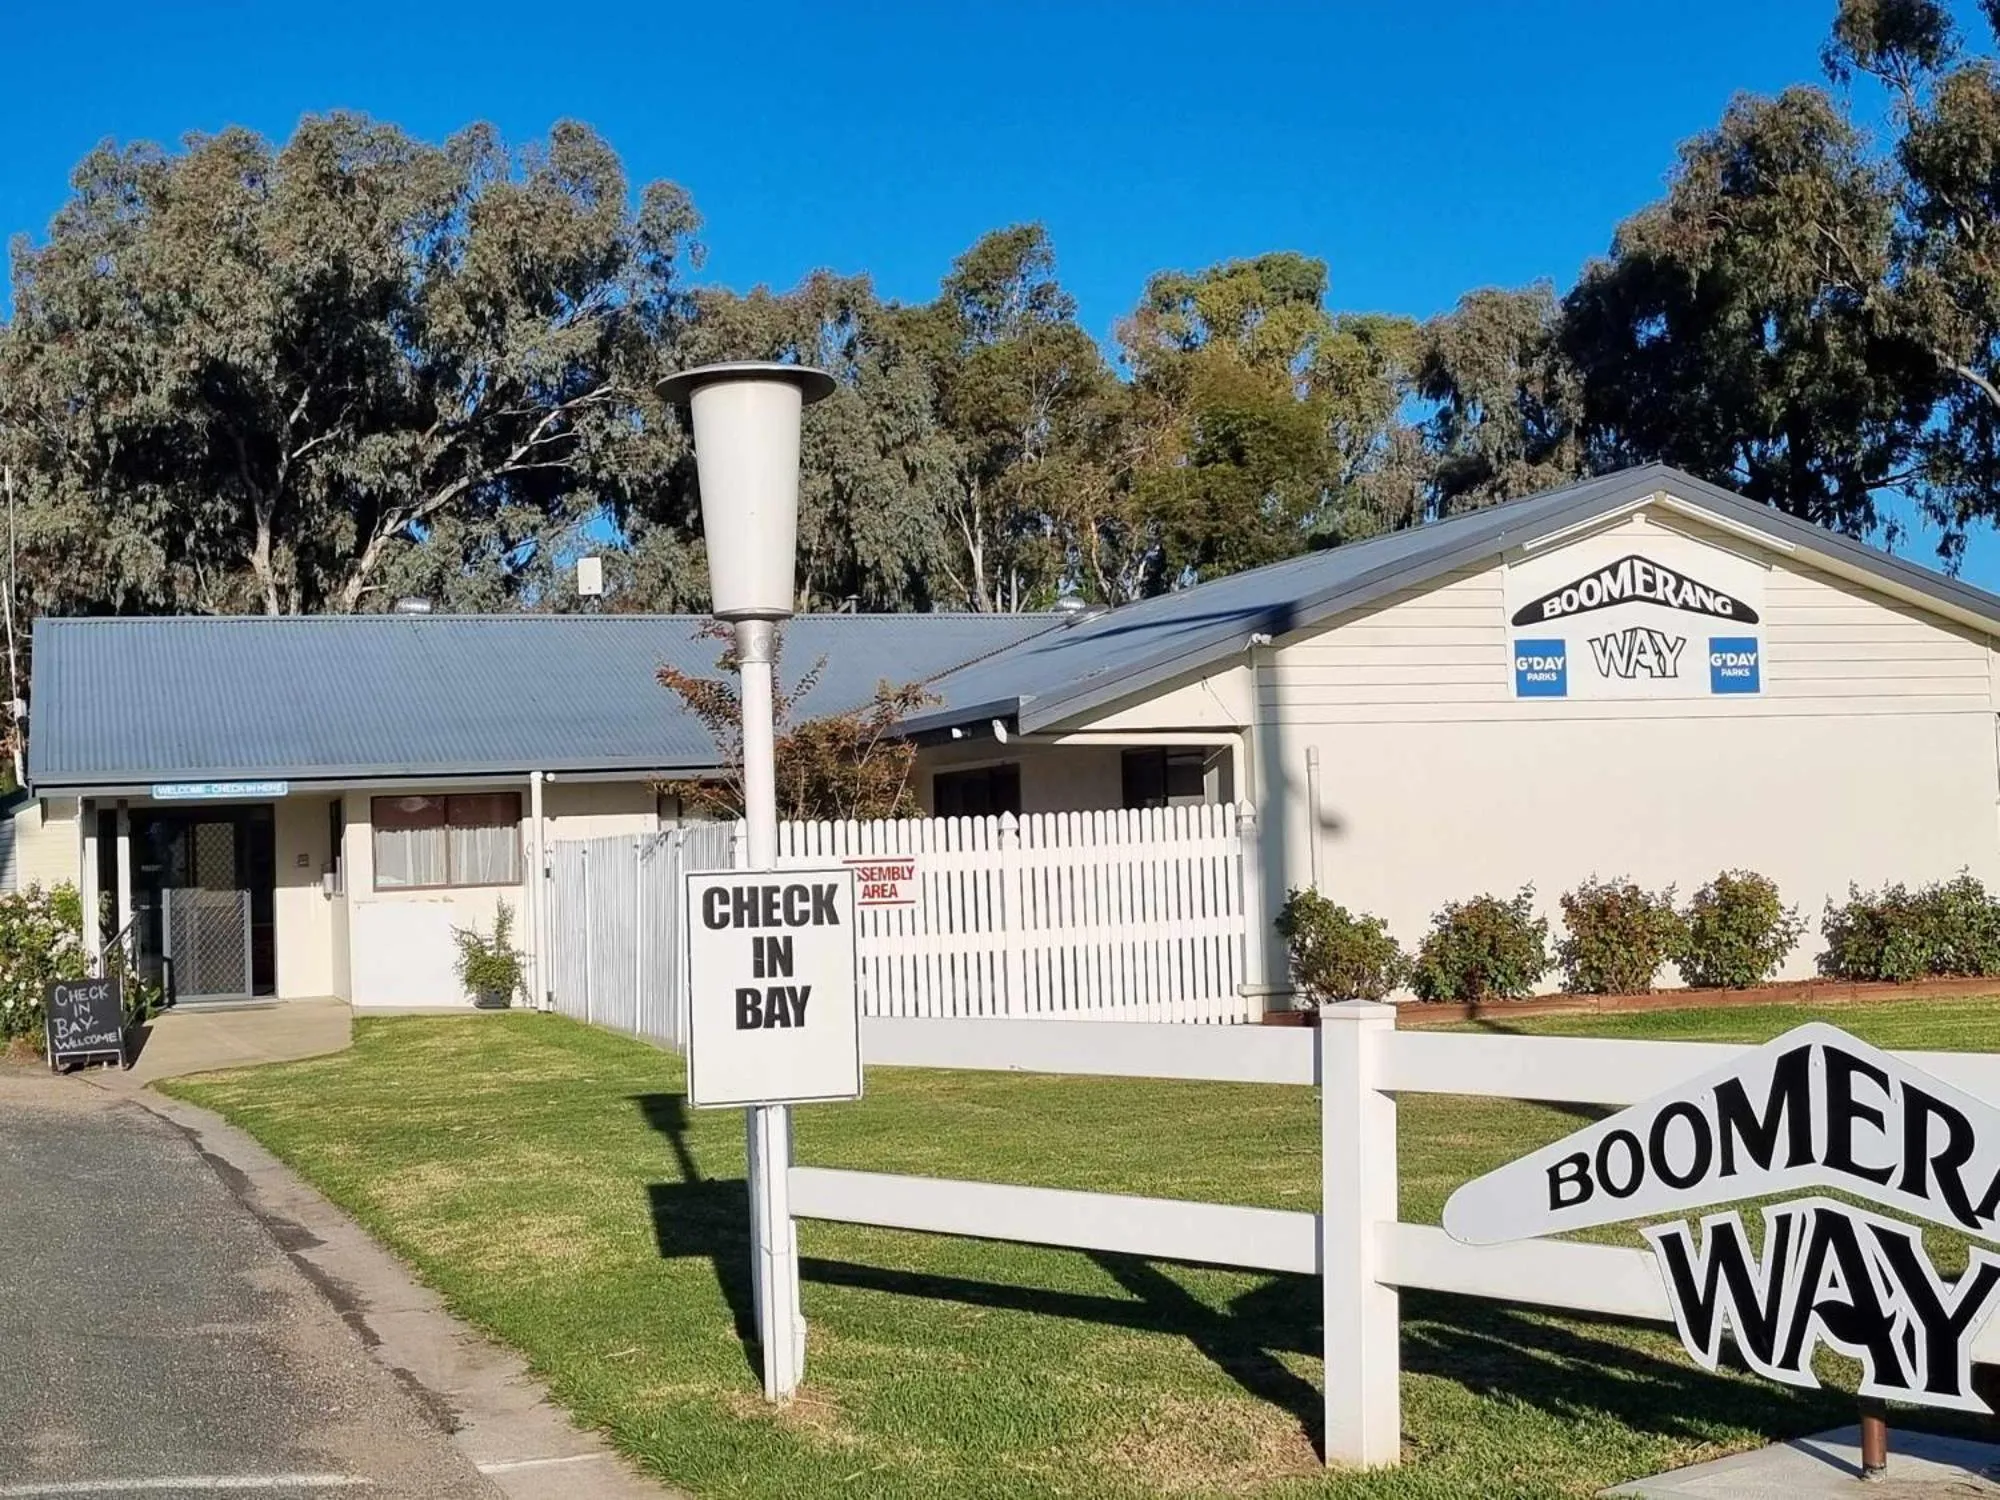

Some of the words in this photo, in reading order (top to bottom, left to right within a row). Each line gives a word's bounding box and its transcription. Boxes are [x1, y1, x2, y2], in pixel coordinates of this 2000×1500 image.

[1542, 559, 1733, 619] BOOMERANG
[1588, 626, 1687, 679] WAY
[1710, 652, 1757, 667] G'DAY
[1516, 656, 1564, 671] G'DAY
[1721, 668, 1750, 677] PARKS
[1527, 672, 1557, 681] PARKS
[158, 784, 205, 794] WELCOME
[212, 783, 245, 793] CHECK
[257, 782, 284, 792] HERE
[862, 883, 898, 898] AREA
[702, 883, 840, 930] CHECK
[752, 935, 794, 978] IN
[55, 983, 109, 1006] CHECK
[73, 1002, 90, 1018] IN
[735, 985, 811, 1030] BAY
[1657, 1207, 2000, 1397] WAY
